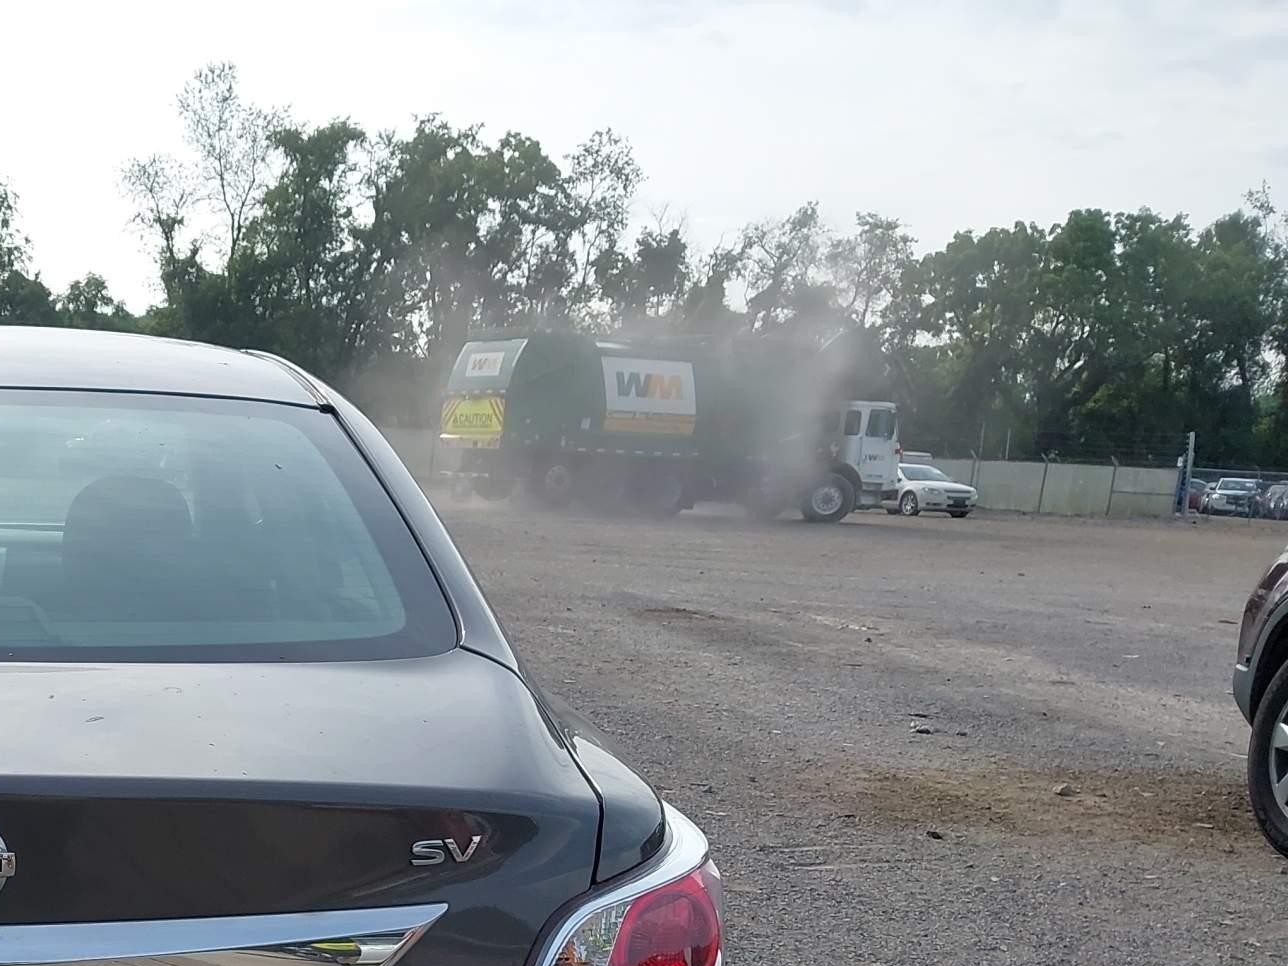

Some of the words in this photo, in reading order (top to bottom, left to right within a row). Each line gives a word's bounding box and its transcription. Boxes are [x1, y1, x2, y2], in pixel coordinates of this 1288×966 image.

[616, 371, 682, 400] WM
[458, 413, 493, 425] CAUTION
[411, 835, 482, 866] SV
